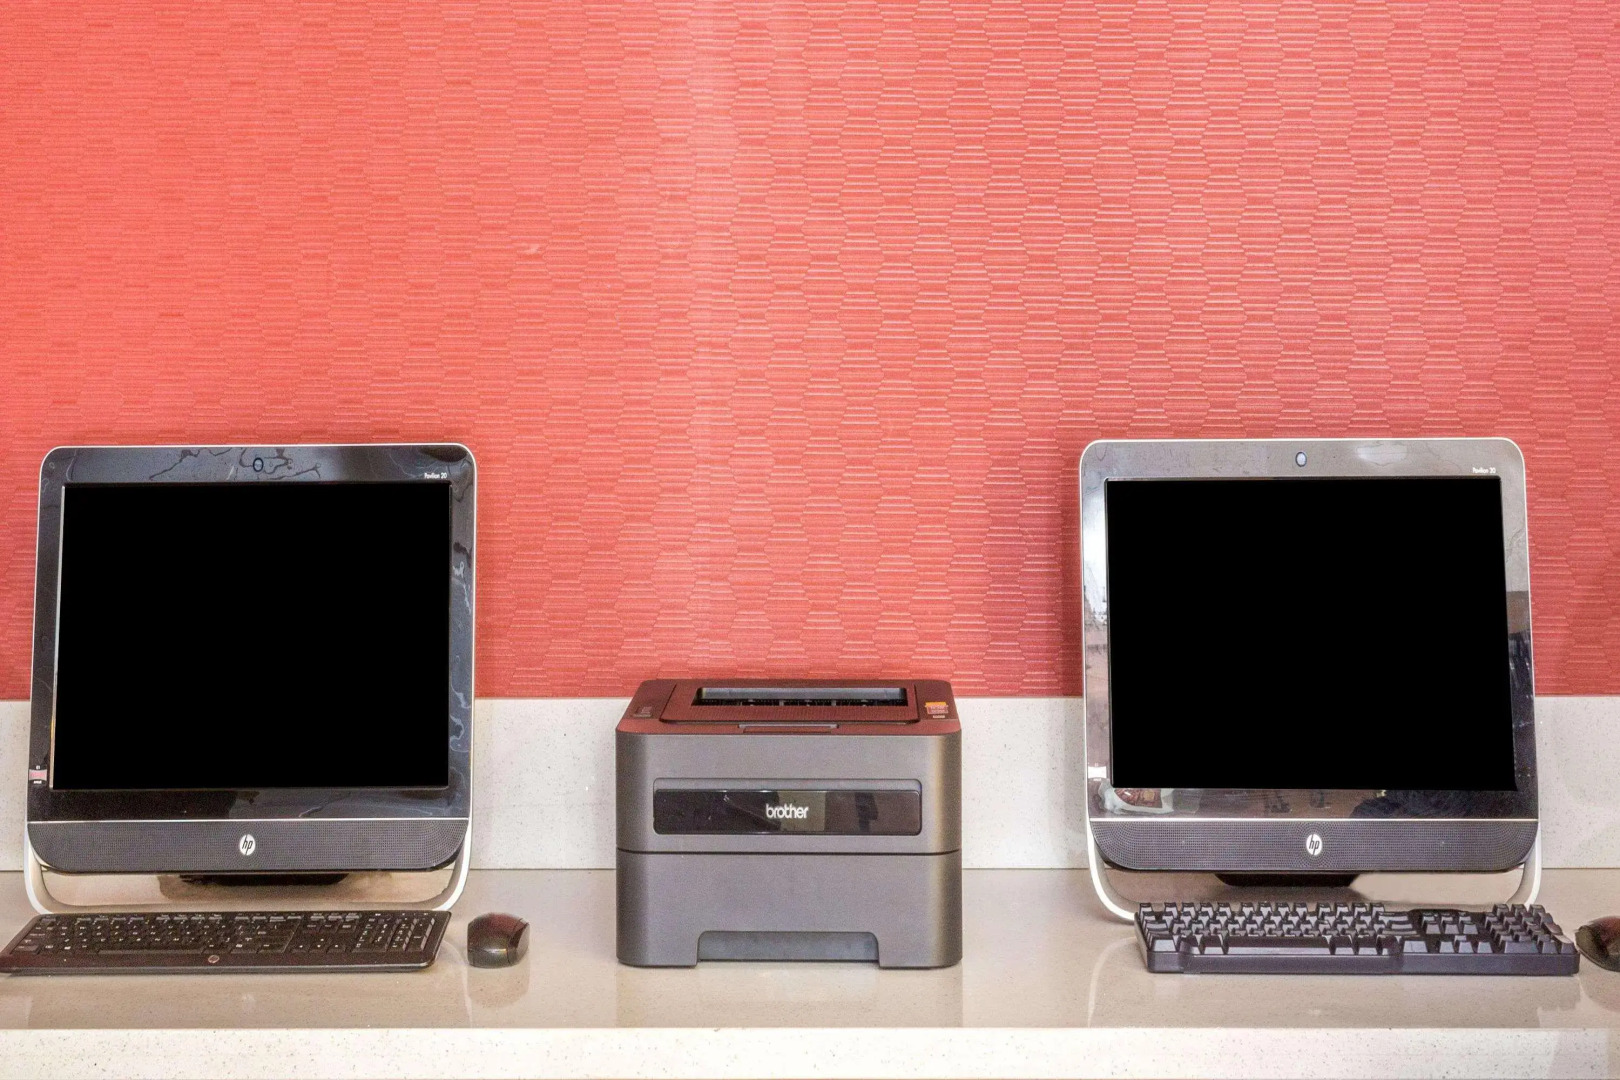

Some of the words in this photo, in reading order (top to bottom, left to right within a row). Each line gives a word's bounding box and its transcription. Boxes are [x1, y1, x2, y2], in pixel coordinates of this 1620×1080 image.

[765, 803, 809, 819] brother
[241, 834, 254, 855] hp
[1308, 834, 1321, 855] hp
